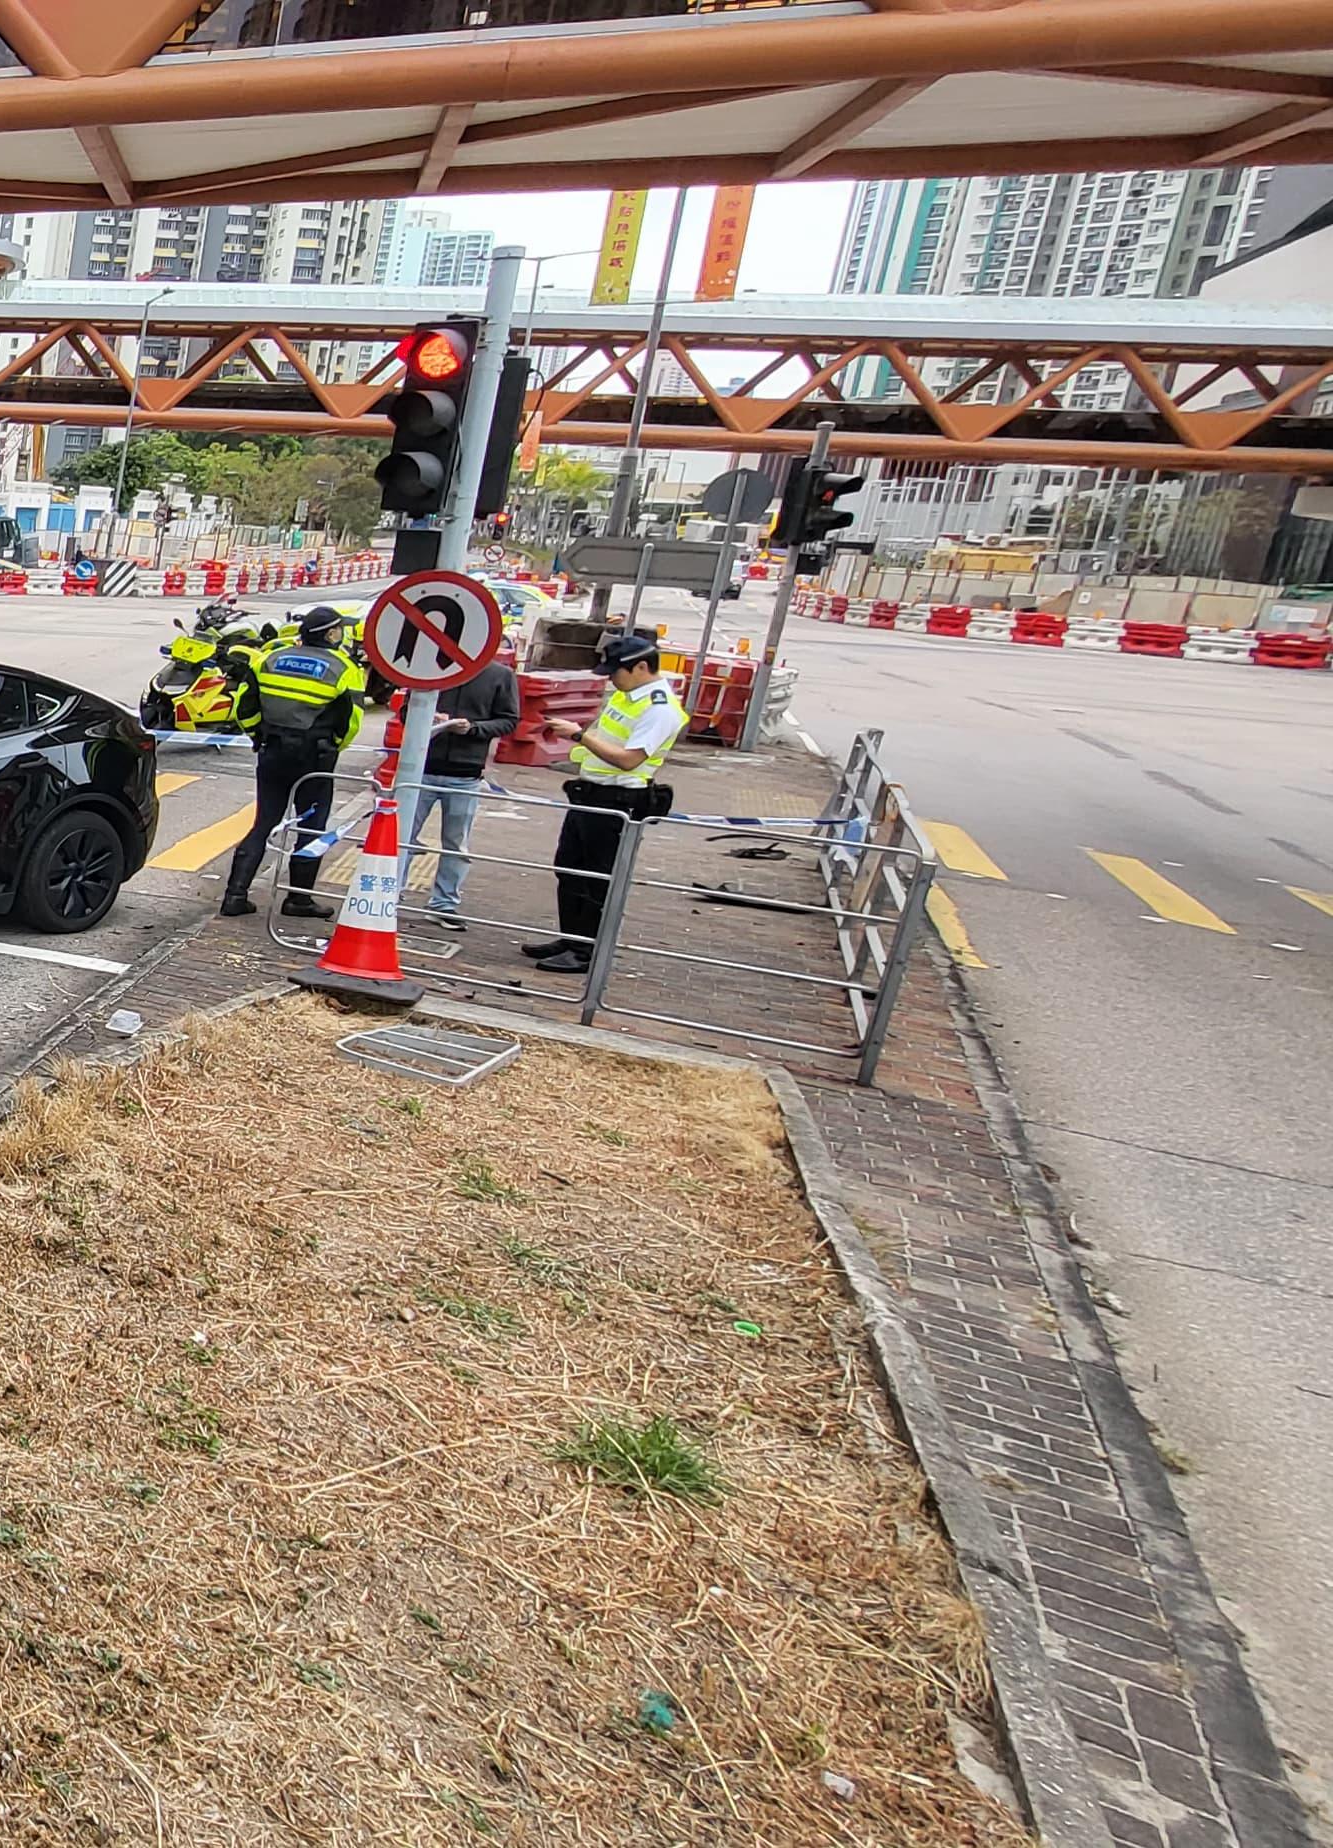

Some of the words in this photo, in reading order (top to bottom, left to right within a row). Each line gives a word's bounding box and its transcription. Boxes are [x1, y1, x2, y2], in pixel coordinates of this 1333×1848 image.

[286, 660, 314, 671] POLICE
[360, 874, 396, 893] 警察
[348, 897, 397, 918] POLIC
